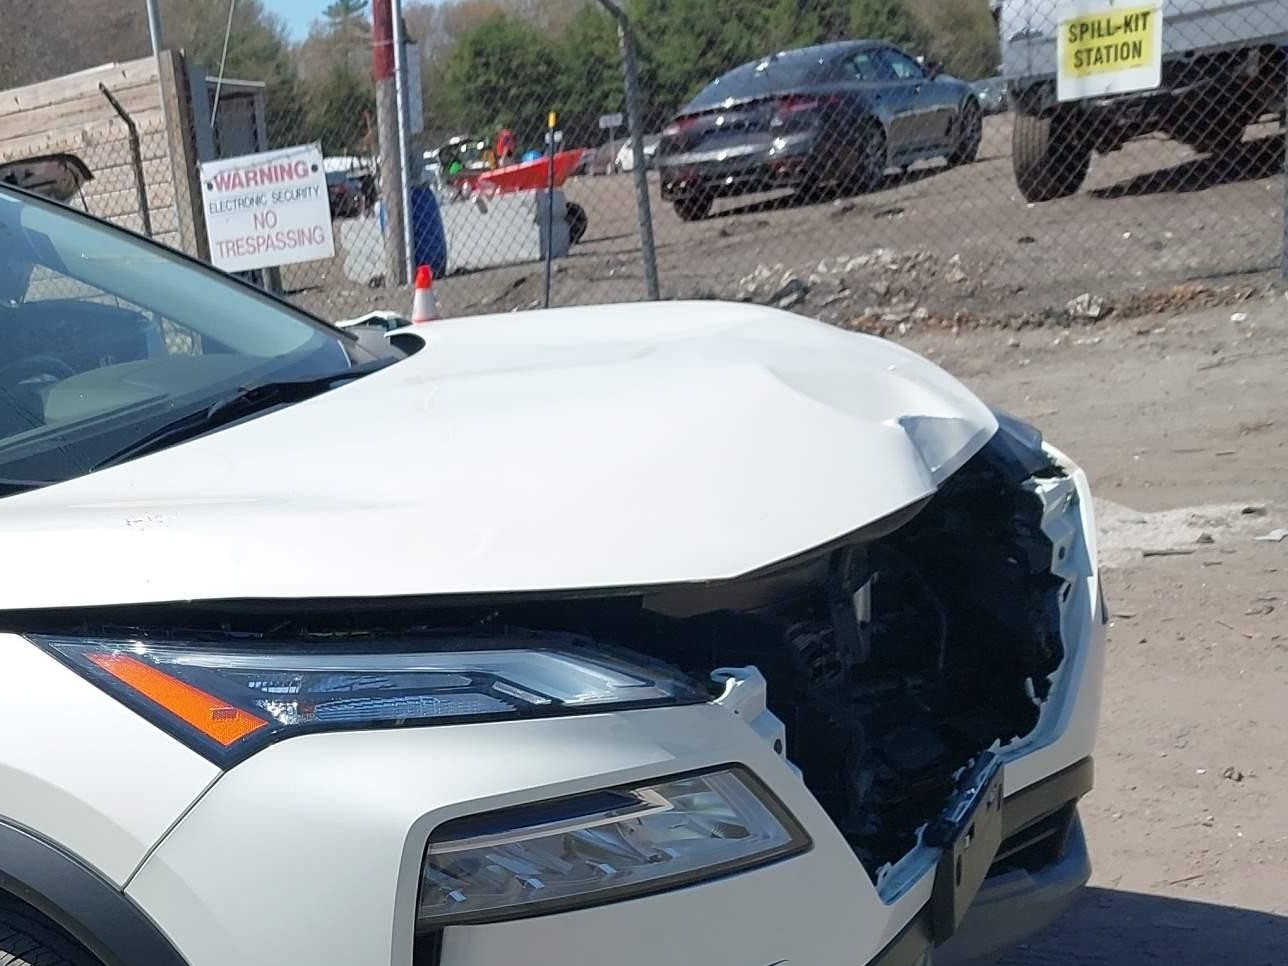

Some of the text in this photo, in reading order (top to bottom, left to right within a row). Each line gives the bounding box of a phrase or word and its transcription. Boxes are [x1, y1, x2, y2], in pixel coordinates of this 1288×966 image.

[1068, 11, 1151, 44] SPILL-KIT
[1074, 40, 1142, 69] STATION
[214, 160, 309, 191] WARNING
[209, 185, 320, 214] ELECTRONIC SECURITY
[253, 210, 278, 231] NO
[216, 224, 325, 259] TRESPASSING
